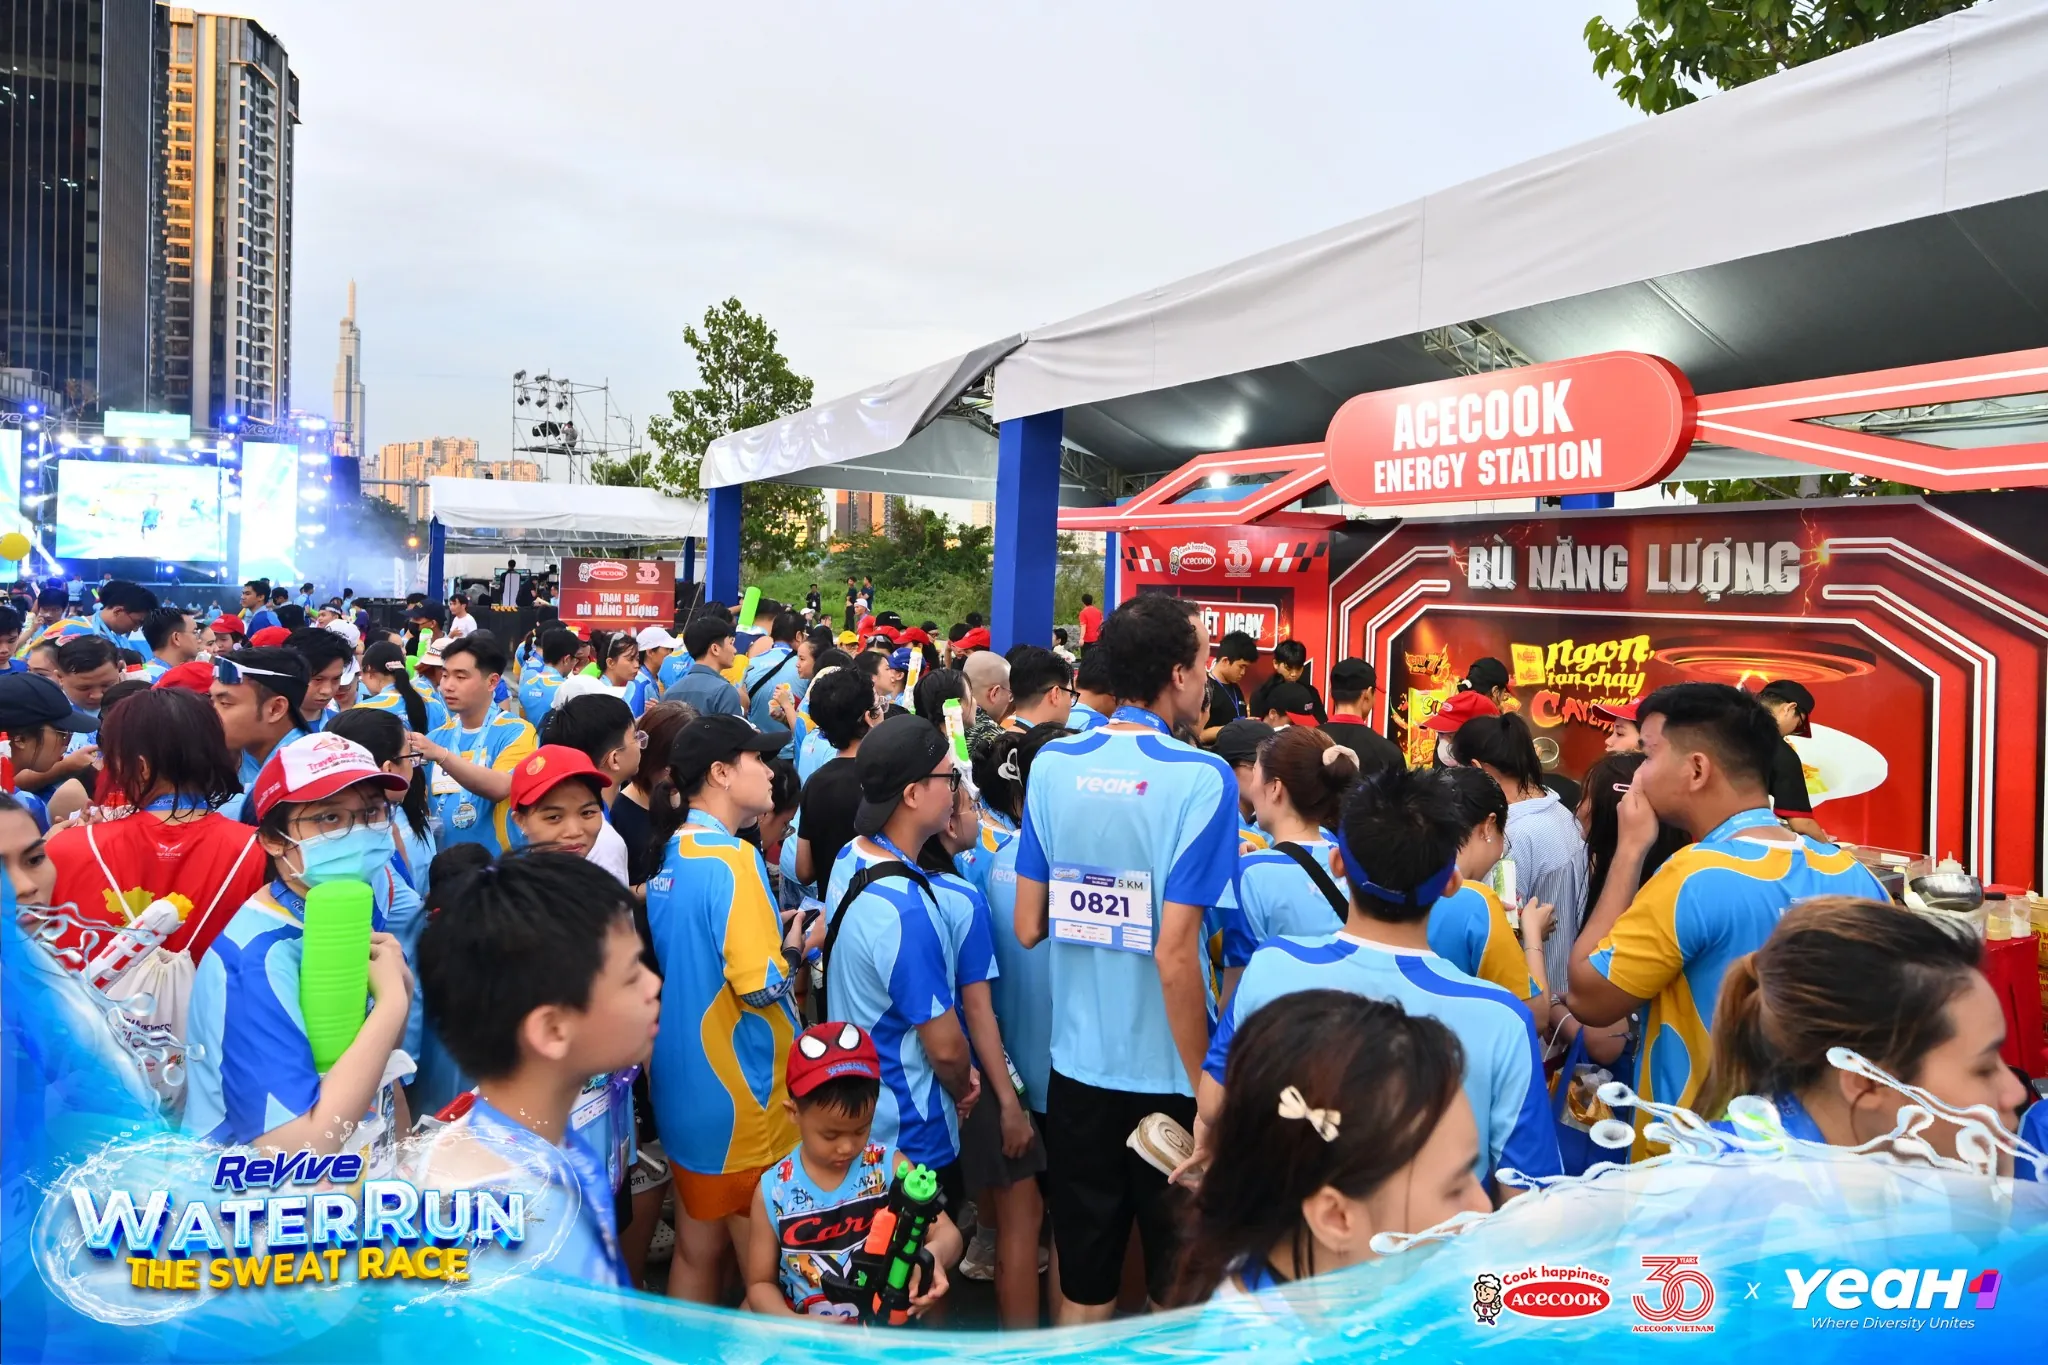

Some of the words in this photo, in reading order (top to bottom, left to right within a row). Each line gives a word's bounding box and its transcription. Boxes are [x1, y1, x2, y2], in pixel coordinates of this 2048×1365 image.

[1393, 378, 1574, 451] ACECOOK
[1374, 452, 1467, 494] ENERGY
[1478, 438, 1602, 486] STATION
[1468, 534, 1516, 590] BÙ
[1528, 536, 1629, 592] NĂNG
[1647, 537, 1801, 602] LƯỢNG
[577, 601, 592, 616] BÙ
[595, 602, 622, 616] NĂNG
[626, 603, 659, 618] LƯỢNG
[1225, 612, 1264, 638] NGAY
[1118, 879, 1124, 888] 5
[1127, 880, 1144, 890] KM
[1070, 890, 1130, 917] 0821
[783, 1213, 877, 1246] Car
